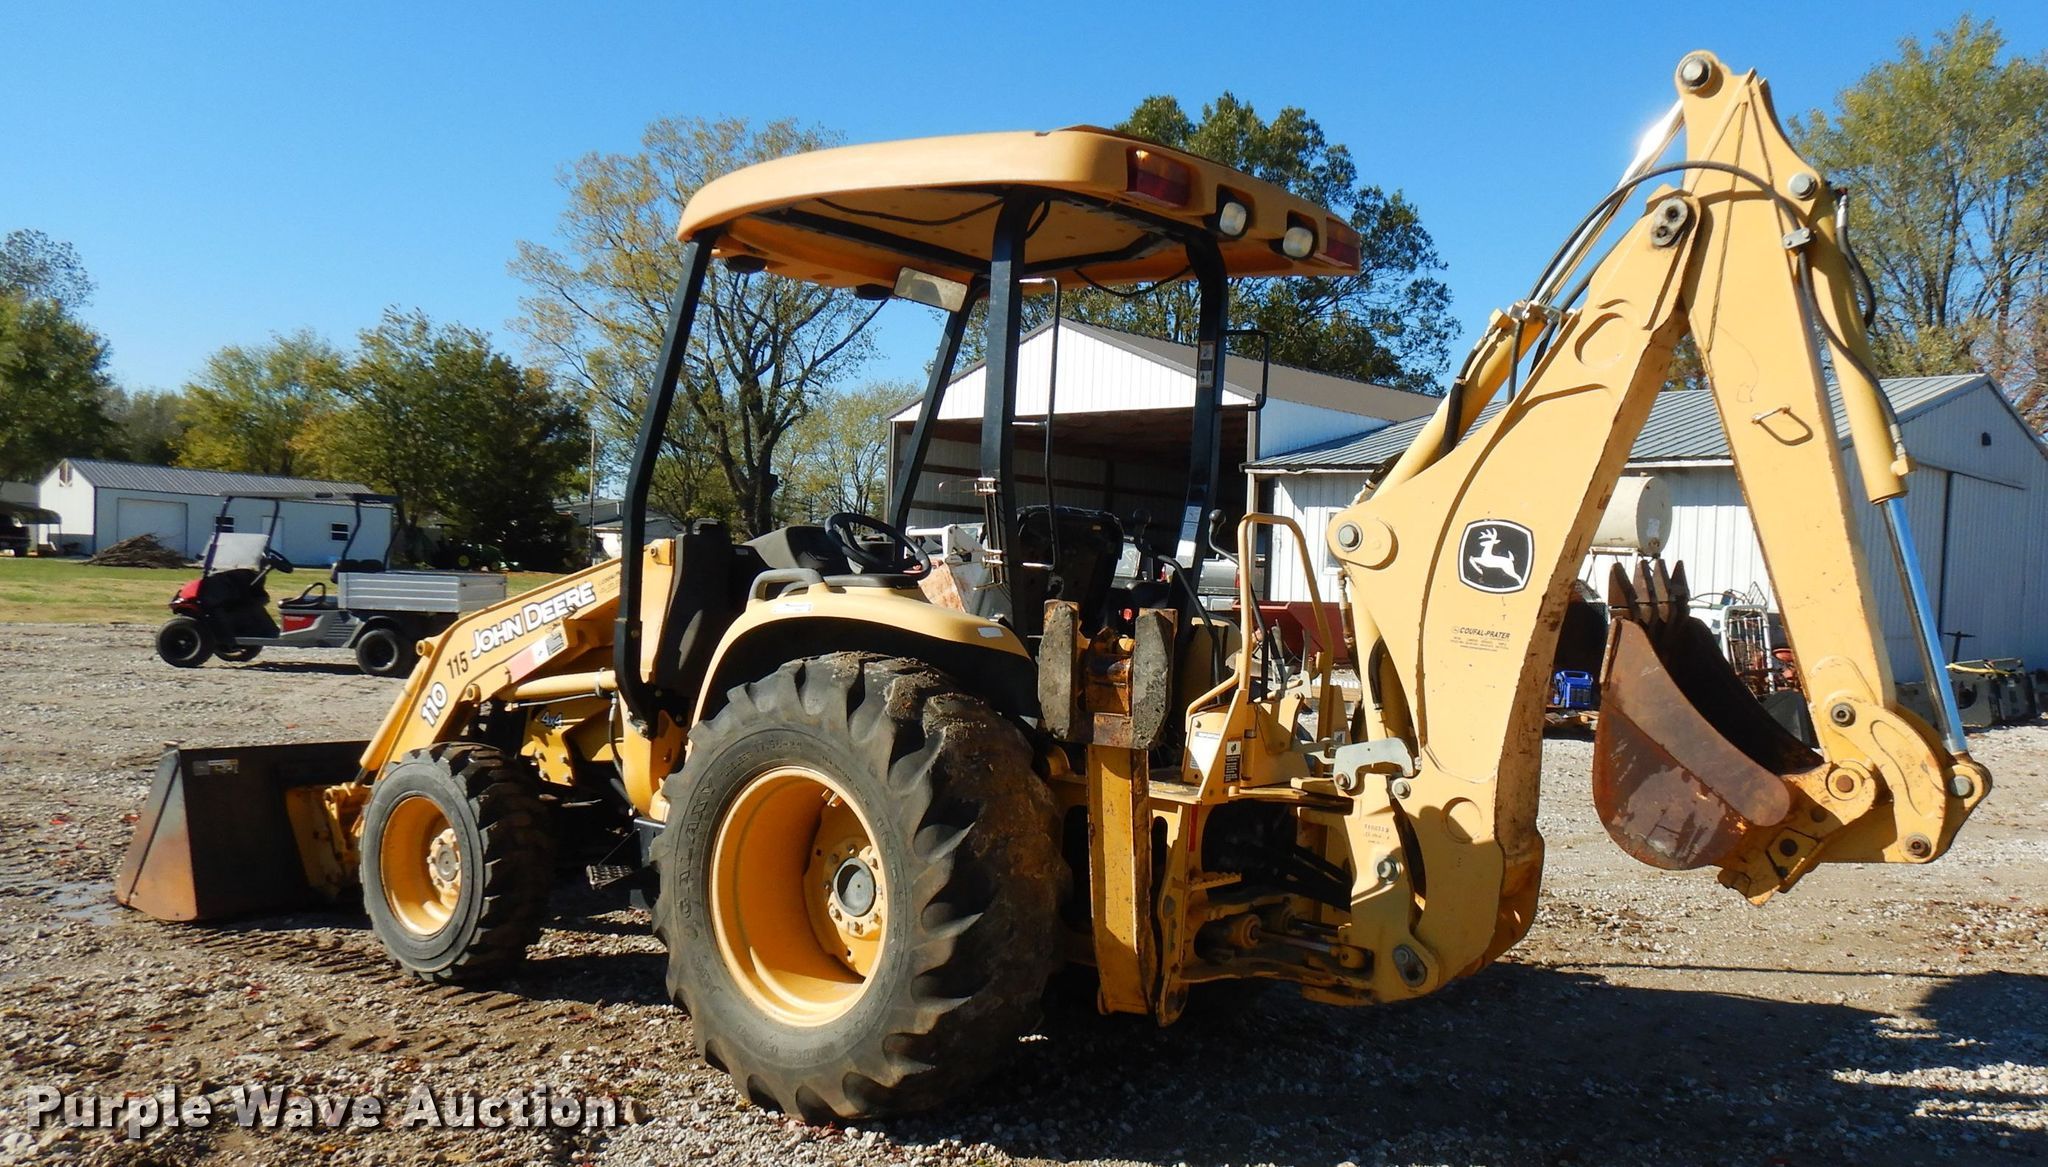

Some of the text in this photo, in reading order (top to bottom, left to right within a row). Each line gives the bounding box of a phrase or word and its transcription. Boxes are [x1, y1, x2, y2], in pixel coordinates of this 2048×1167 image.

[472, 613, 524, 660] JOHN
[522, 581, 597, 633] DEERE
[1459, 626, 1511, 639] COUFAL-PRATER
[446, 651, 469, 679] 115
[420, 682, 448, 727] 110
